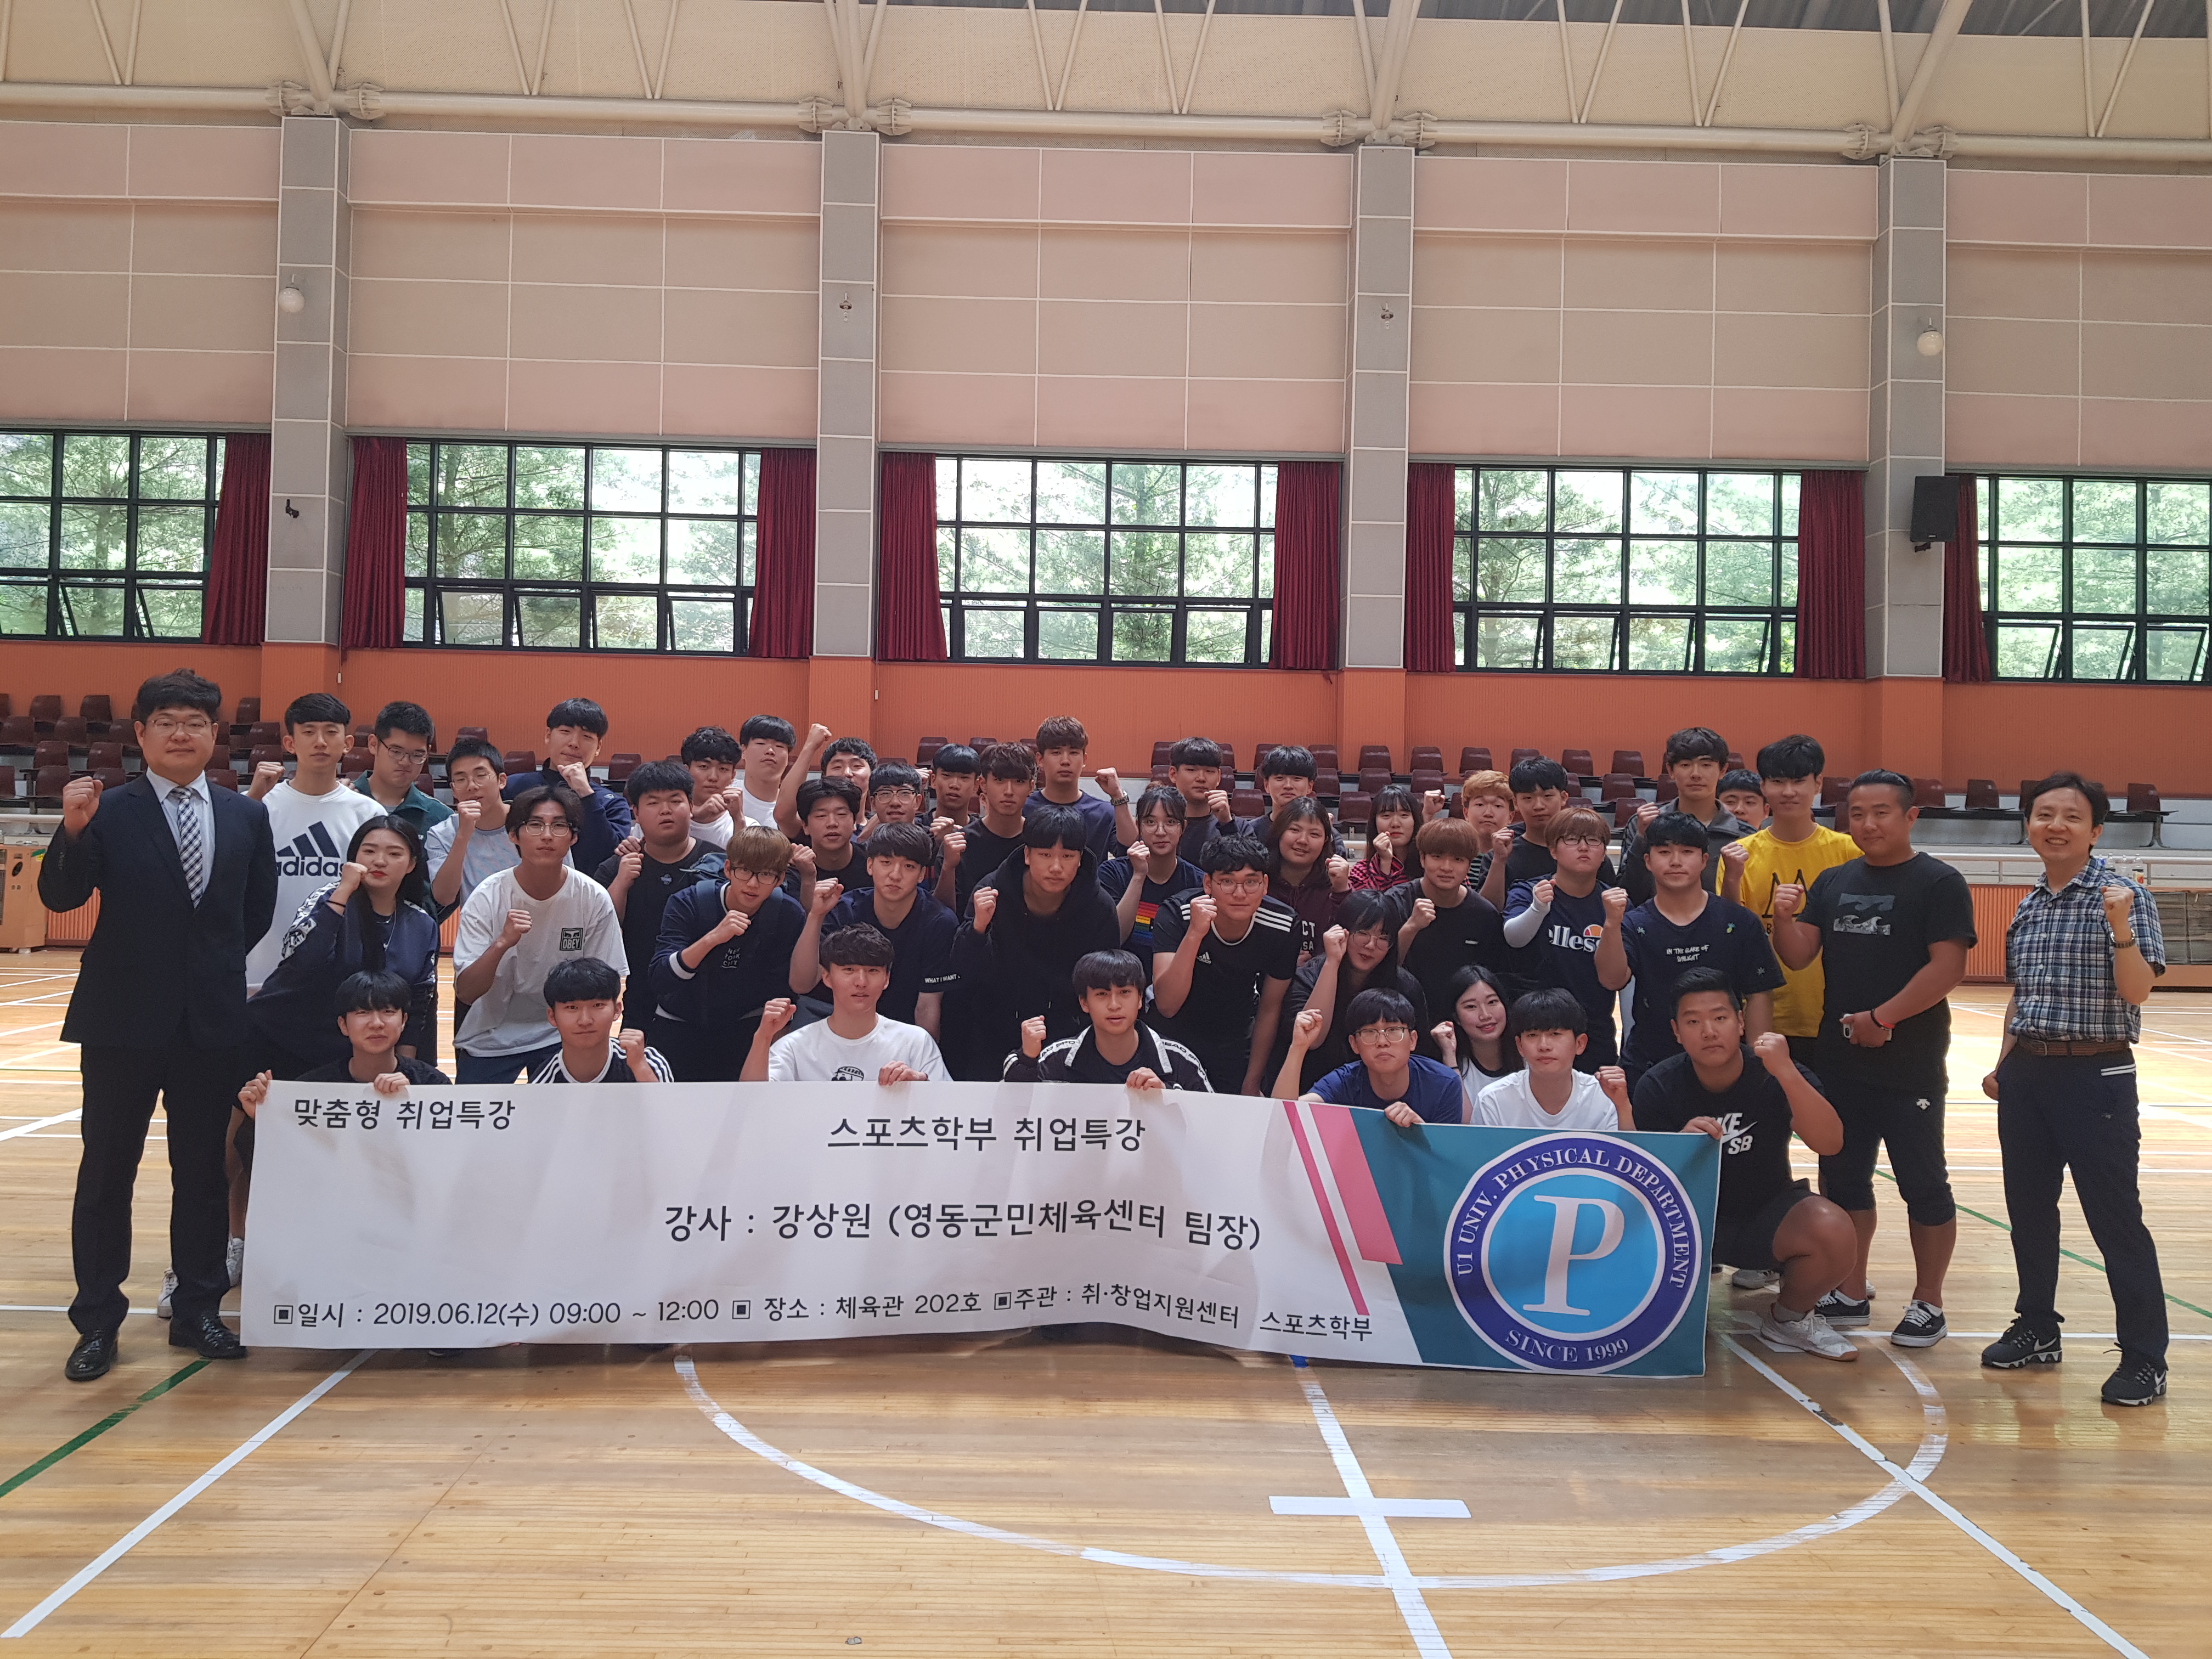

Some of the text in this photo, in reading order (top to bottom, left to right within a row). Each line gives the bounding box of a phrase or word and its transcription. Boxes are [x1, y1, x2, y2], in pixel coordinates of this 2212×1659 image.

[562, 938, 580, 949] OBEY
[1548, 924, 1601, 952] lles
[295, 1099, 516, 1130] 맞춤형 취업특강
[827, 1116, 1146, 1152] 스포츠학부 취업특강
[1728, 1135, 1753, 1155] SB
[665, 1205, 732, 1242] 강사
[772, 1203, 870, 1239] 강상원
[889, 1199, 1165, 1238] (영동군민체육센터
[1186, 1211, 1260, 1251] 팀장)
[1458, 1190, 1498, 1244] UNIV.
[1492, 1148, 1610, 1192] PHYSICAL
[1614, 1155, 1690, 1288] DEPARTMENT
[1523, 1195, 1625, 1317] P
[298, 1302, 344, 1328] 일시
[373, 1302, 539, 1327] 2019.06.12(수)
[550, 1302, 621, 1324] 09:00
[658, 1299, 720, 1322] 12:00
[764, 1297, 809, 1322] 장소
[836, 1295, 904, 1319] 체육관
[915, 1291, 982, 1314] 202호
[1014, 1286, 1058, 1310] 주관
[1260, 1313, 1373, 1341] 스포츠학부
[1505, 1329, 1629, 1363] SINCE 1999
